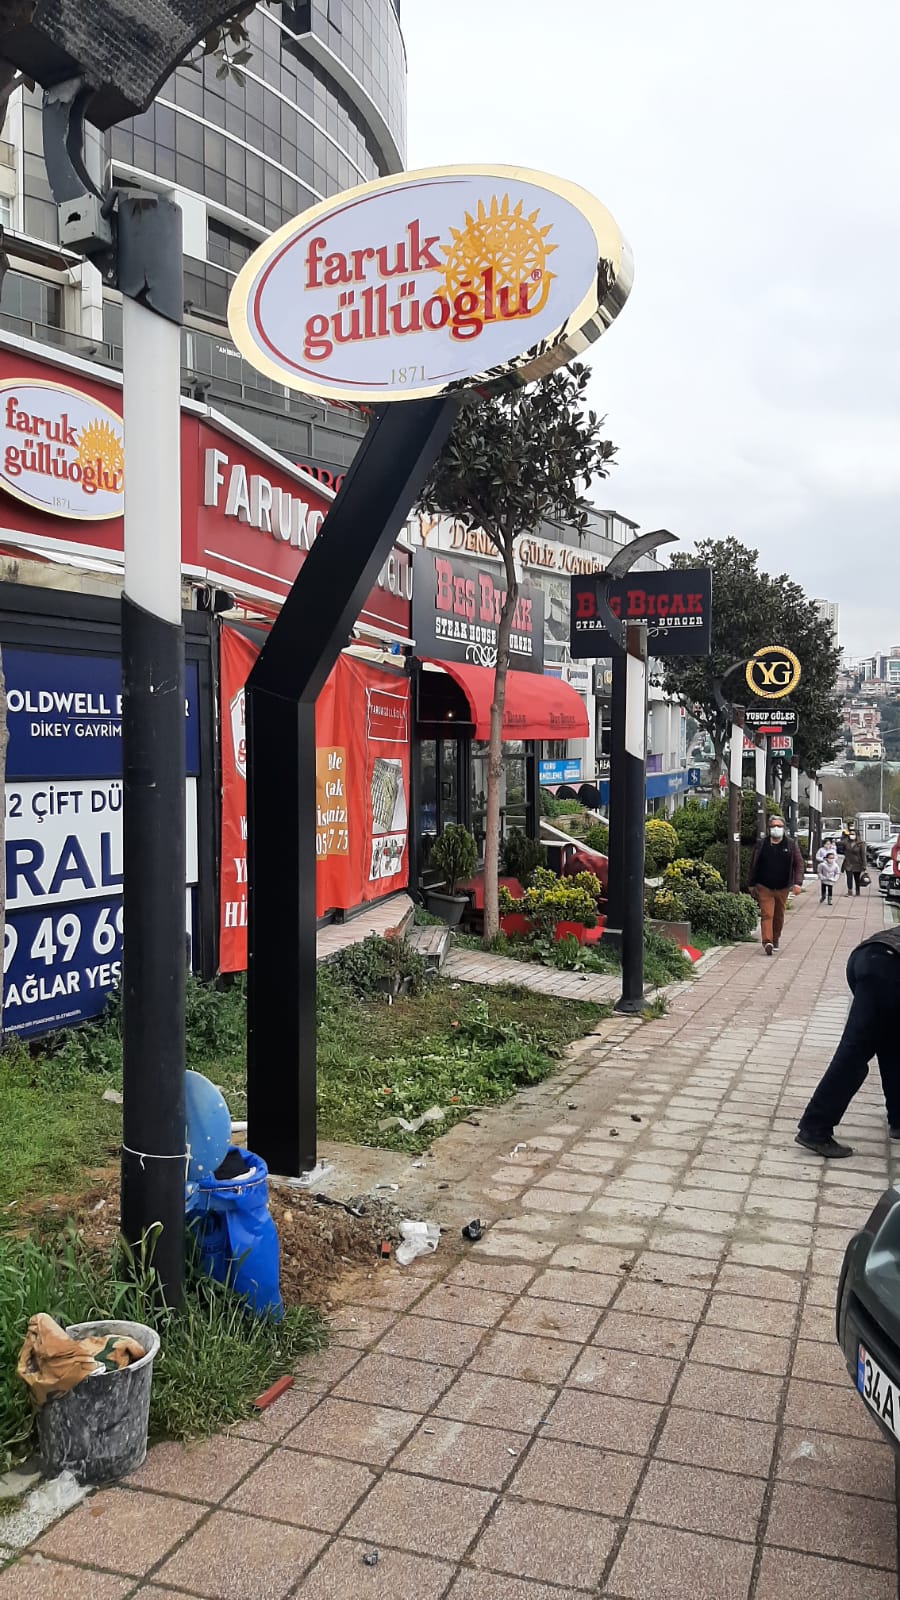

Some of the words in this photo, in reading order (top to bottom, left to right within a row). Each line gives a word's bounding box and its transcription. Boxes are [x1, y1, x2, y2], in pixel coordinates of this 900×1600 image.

[304, 218, 441, 290] faruk
[302, 266, 532, 361] güllüoğlu
[388, 365, 428, 385] 1871
[5, 396, 79, 447] faruk
[4, 438, 122, 495] güllüoğlu
[434, 556, 475, 623] BEŞ
[626, 589, 703, 618] BIÇAK
[435, 616, 467, 640] STEAK
[469, 626, 496, 644] HOUSE
[576, 620, 606, 629] STEA
[756, 660, 793, 685] YG
[6, 689, 111, 715] OLDWELL
[31, 719, 71, 737] DİKEY
[74, 723, 122, 738] GAYRİM
[31, 785, 83, 823] ÇİFT
[30, 913, 82, 966] 49
[4, 970, 81, 1009] AĞLAR
[864, 1359, 880, 1413] 34
